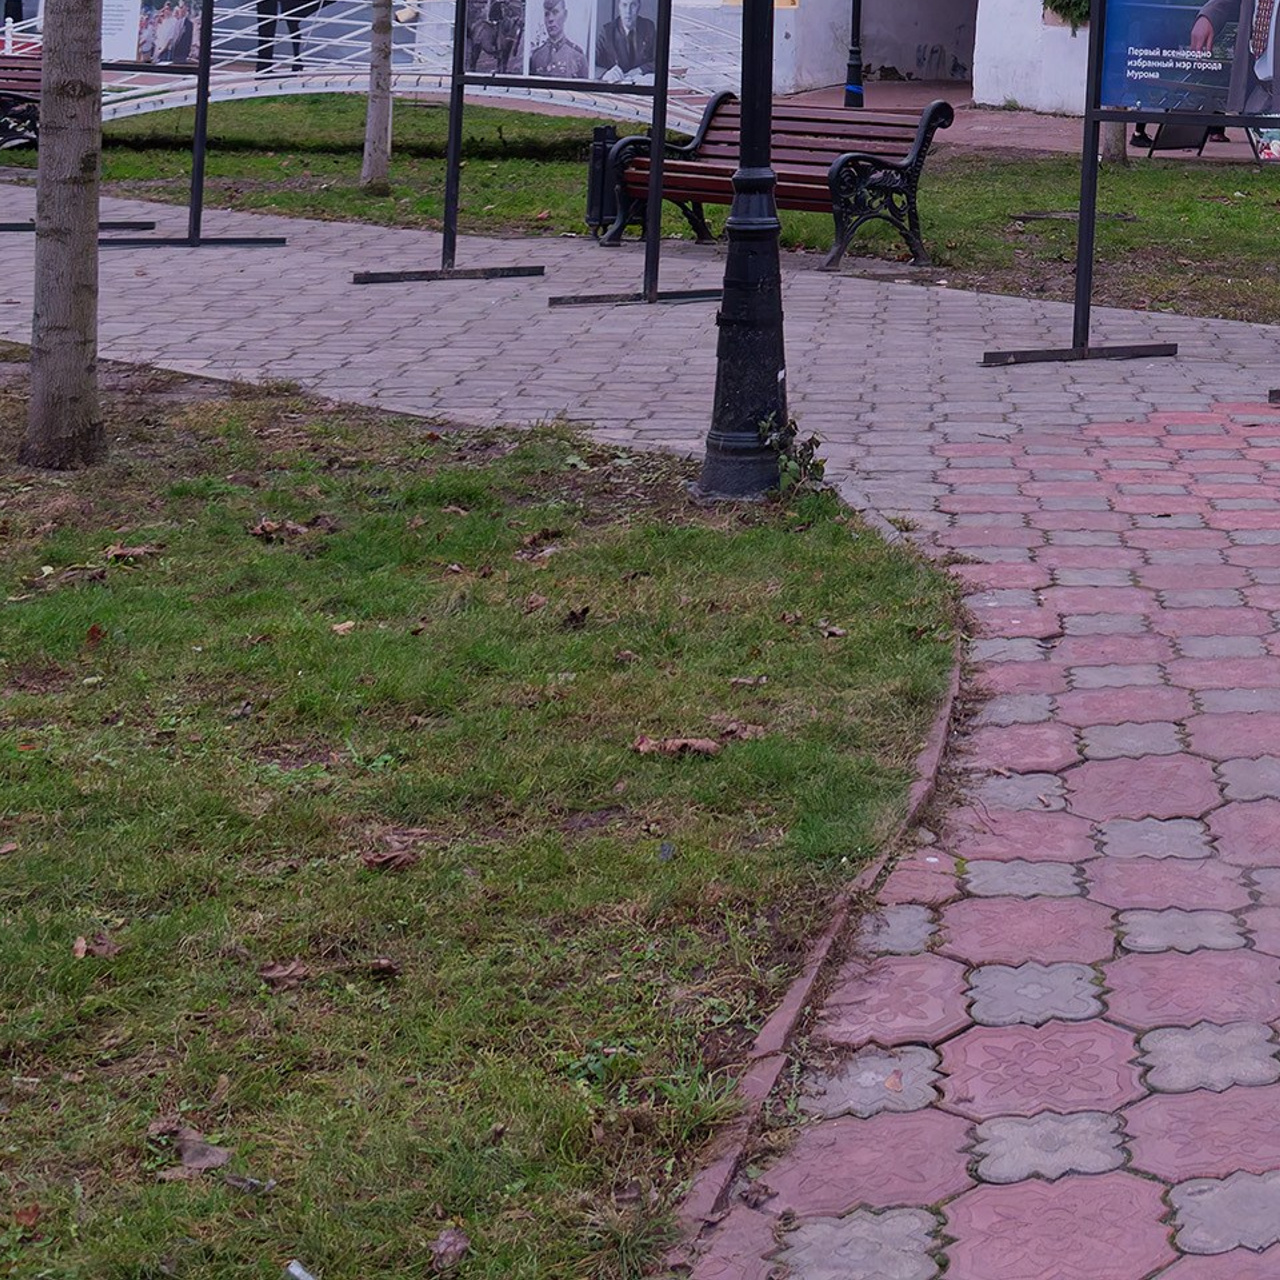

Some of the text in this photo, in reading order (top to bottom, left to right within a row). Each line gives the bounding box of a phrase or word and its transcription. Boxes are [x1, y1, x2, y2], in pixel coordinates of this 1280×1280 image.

[1127, 46, 1212, 59] Первый всенародно
[1127, 58, 1223, 71] избранный мэр города
[1126, 69, 1160, 80] Мурома
